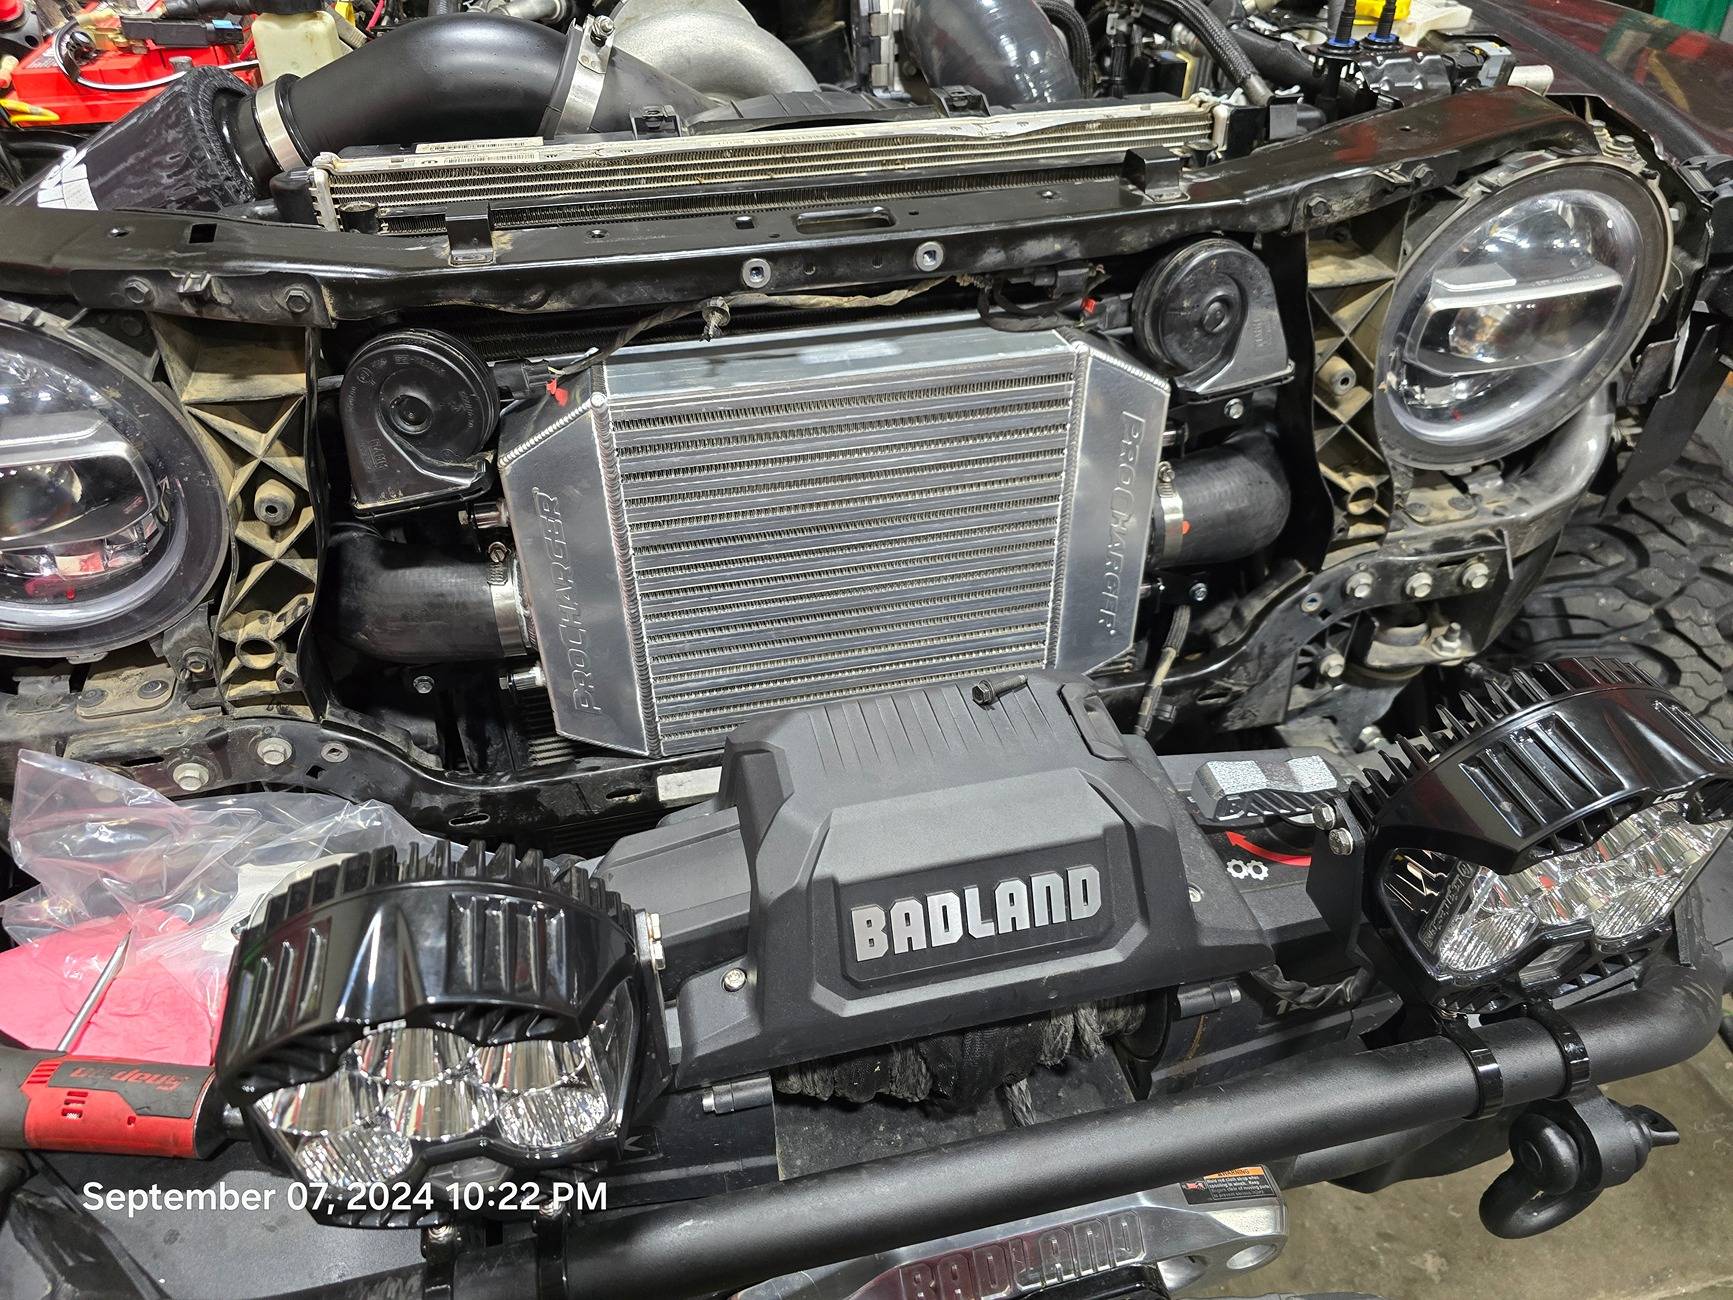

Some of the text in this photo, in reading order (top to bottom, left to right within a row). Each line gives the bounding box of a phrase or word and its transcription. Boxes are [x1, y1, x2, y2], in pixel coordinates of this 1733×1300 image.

[534, 490, 601, 711] PROCHARGER
[1099, 411, 1146, 633] PROCHARGER
[850, 864, 1101, 962] BADLAND
[899, 1209, 1155, 1300] BADLAND
